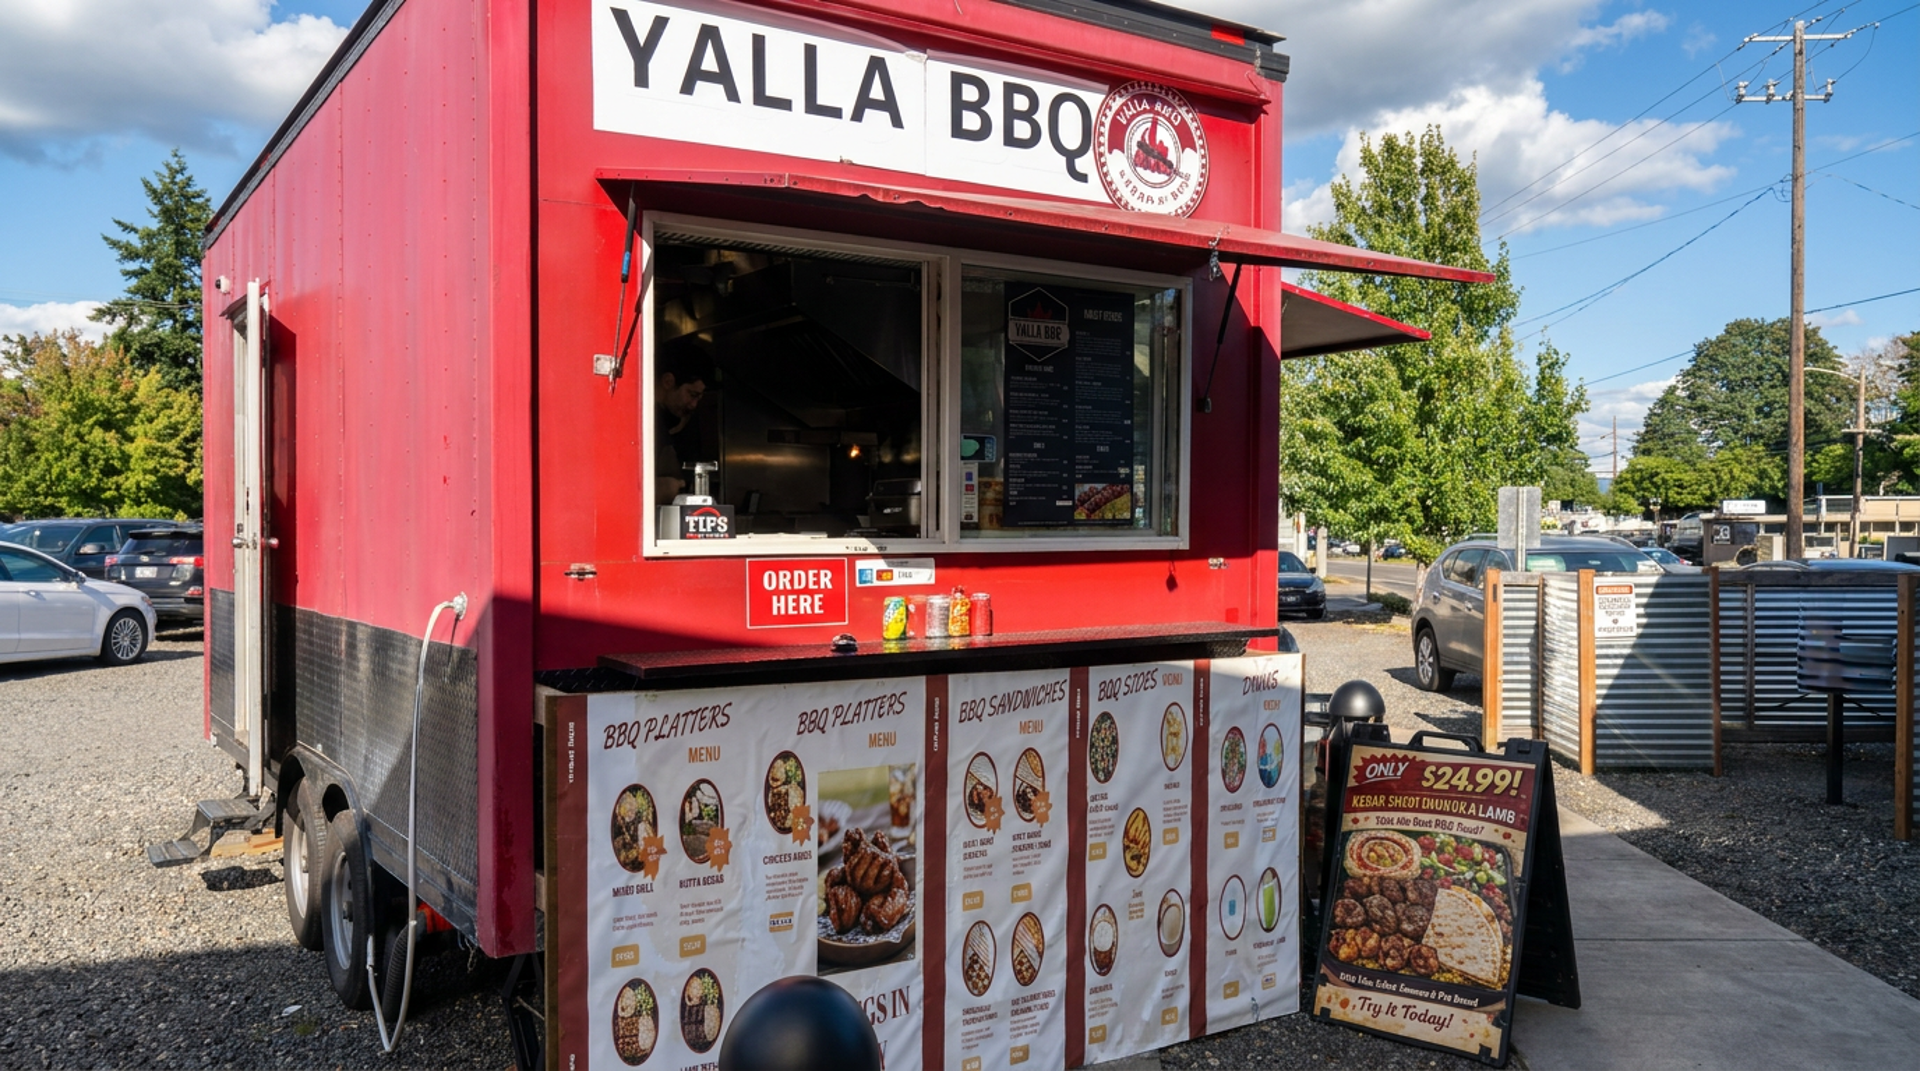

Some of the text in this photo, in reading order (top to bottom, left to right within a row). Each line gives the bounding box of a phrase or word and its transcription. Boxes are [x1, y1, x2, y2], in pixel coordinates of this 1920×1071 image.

[609, 7, 1093, 183] YALLA BBQ
[1015, 322, 1042, 339] YALLA
[685, 516, 728, 533] TIPS
[762, 569, 833, 591] ORDER
[772, 594, 824, 616] HERE
[797, 708, 829, 736] BBQ
[831, 692, 908, 728] PLATTERS
[958, 698, 986, 723] BBQ
[603, 702, 733, 750] BBQ PLATTERS
[868, 731, 897, 748] MENU
[688, 746, 721, 764] MENU
[1365, 761, 1524, 797] ONLY $24.99!
[1478, 804, 1517, 824] LAMB
[891, 985, 911, 1019] IN
[1358, 996, 1383, 1019] Try
[1401, 1004, 1455, 1033] Today!
